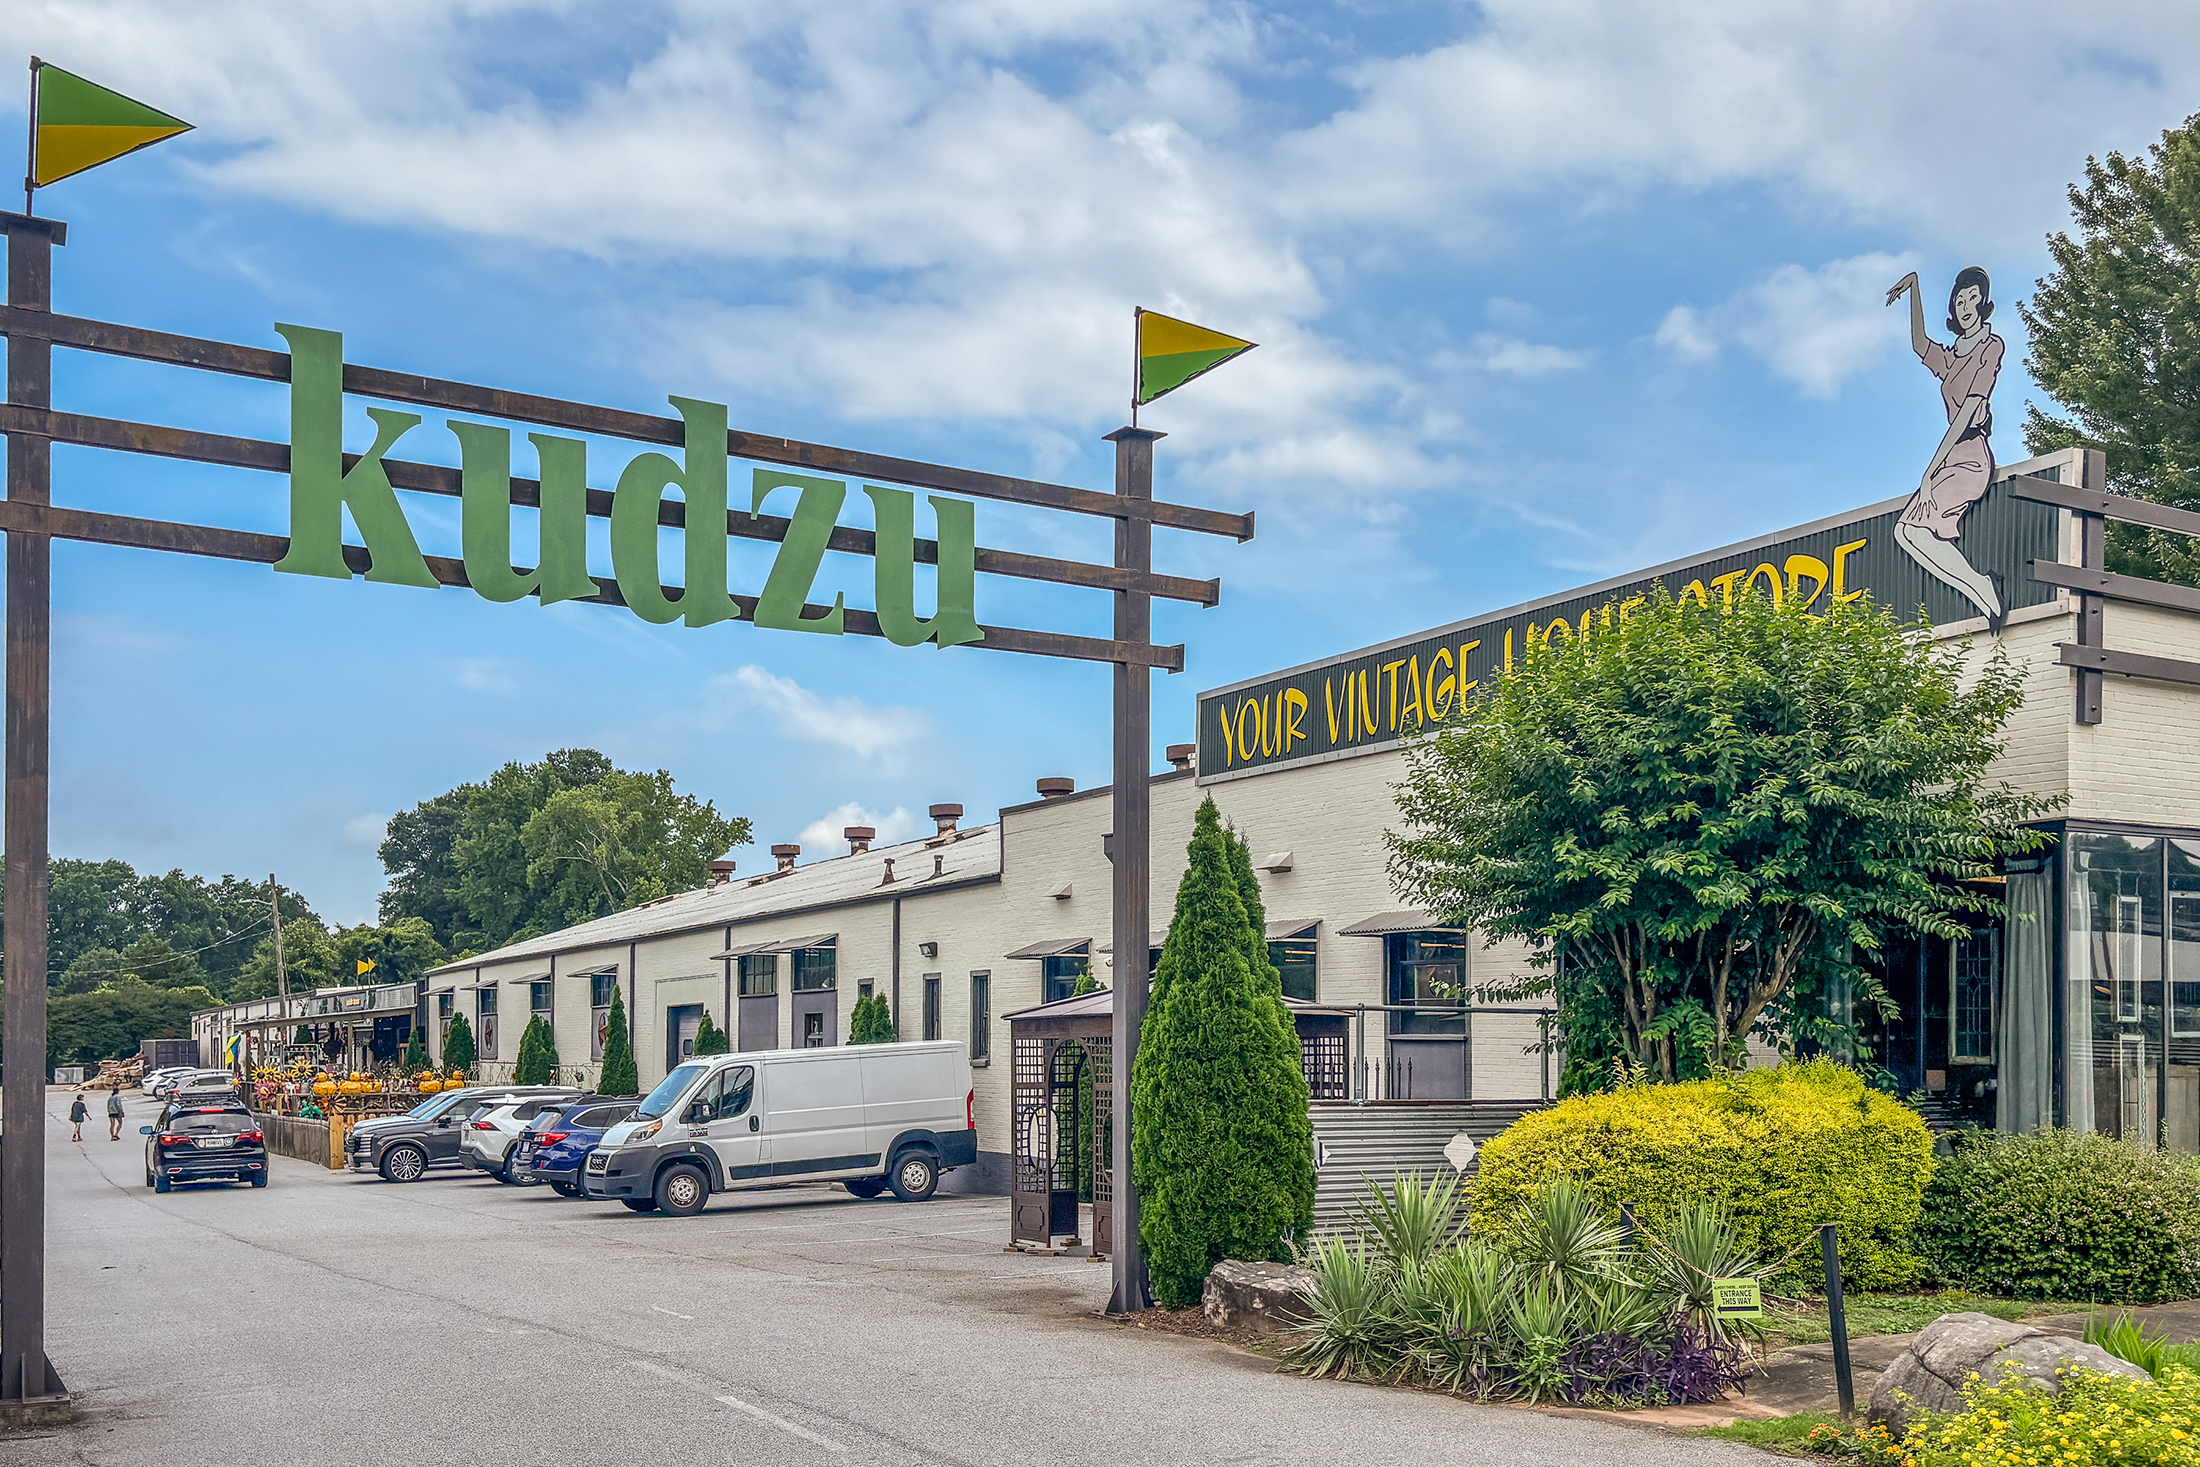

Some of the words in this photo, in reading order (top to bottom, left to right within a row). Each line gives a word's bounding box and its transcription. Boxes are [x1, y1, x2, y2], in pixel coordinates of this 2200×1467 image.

[273, 322, 986, 650] kudzu
[1221, 687, 1308, 768] YOUR
[1324, 639, 1482, 745] VINTAGE
